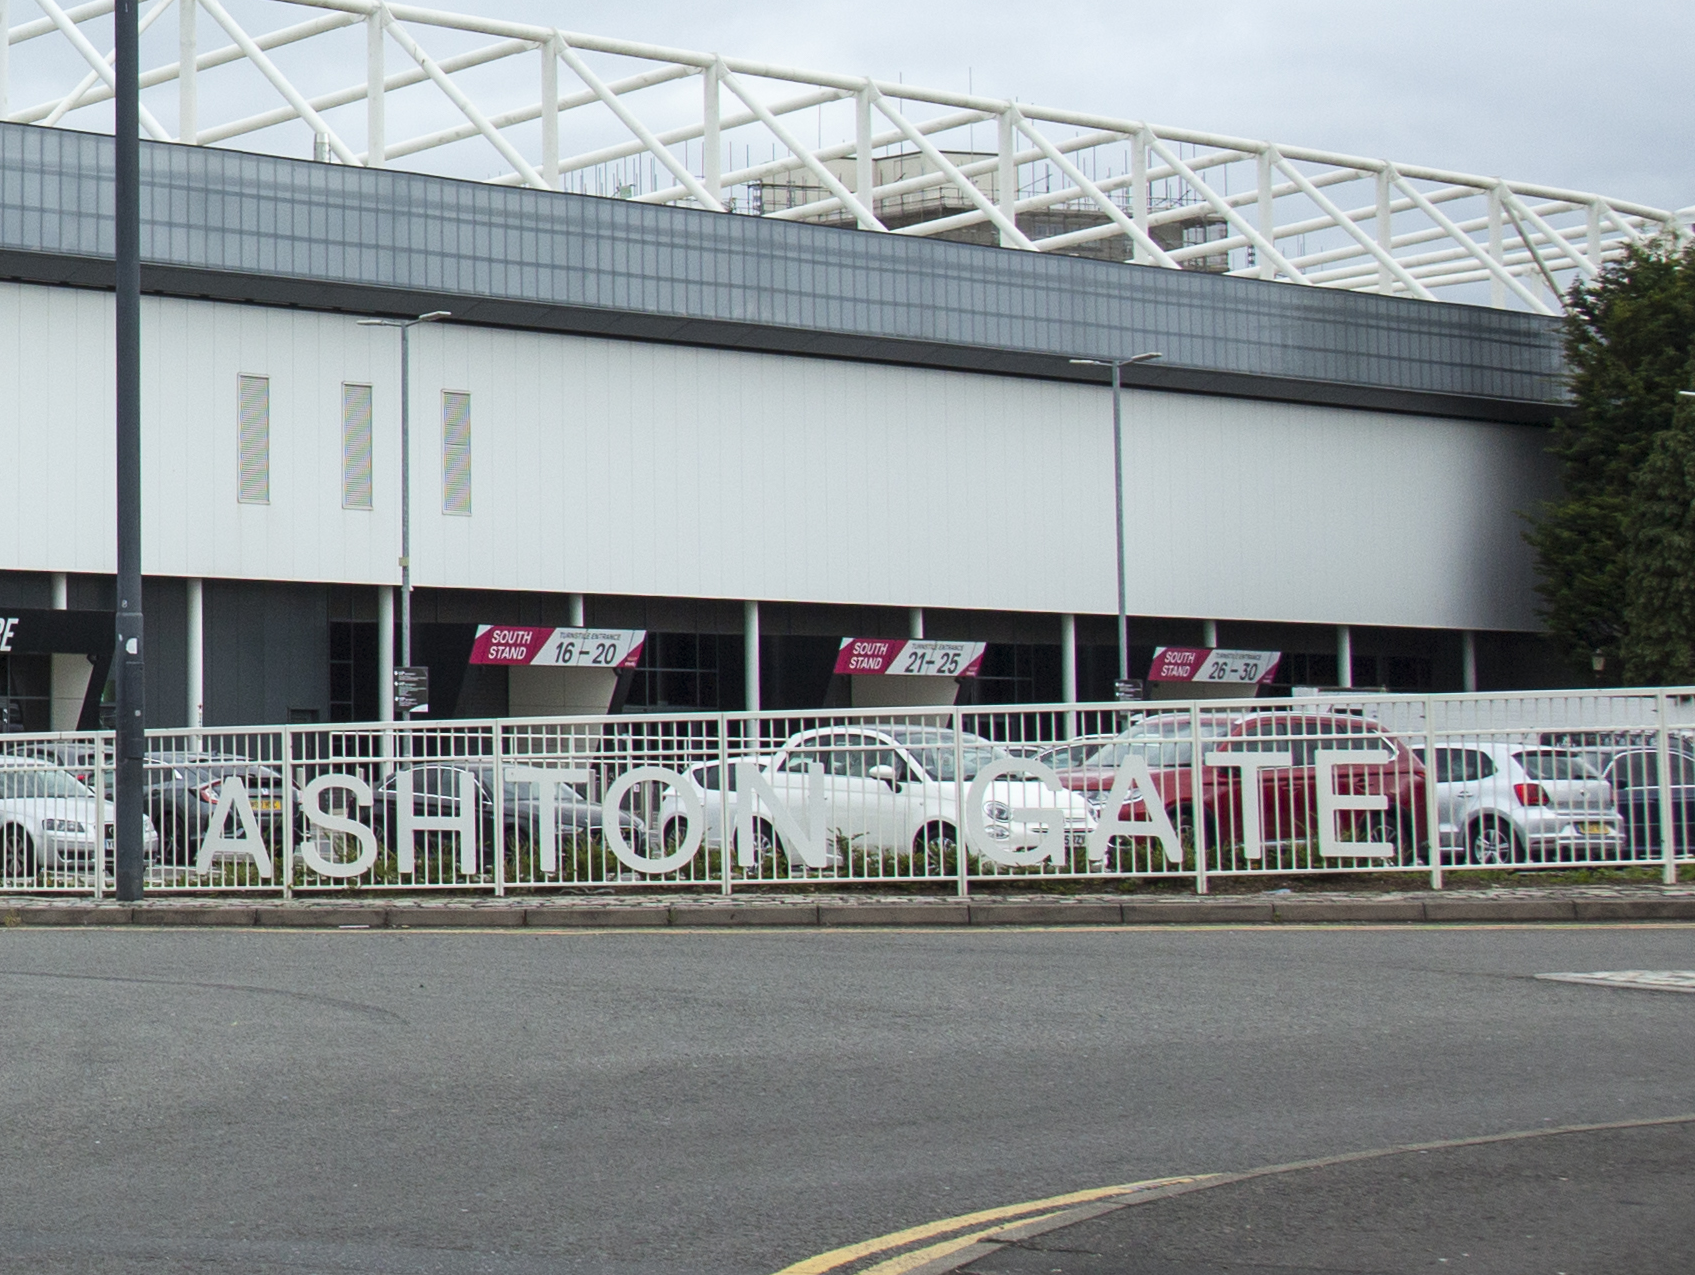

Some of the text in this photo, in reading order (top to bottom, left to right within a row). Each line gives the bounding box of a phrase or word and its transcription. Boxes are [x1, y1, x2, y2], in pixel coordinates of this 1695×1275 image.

[491, 629, 533, 645] SOUTH
[488, 645, 527, 660] STAND
[555, 641, 576, 664] 16
[592, 642, 617, 665] 20
[853, 642, 889, 656] SOUTH
[849, 656, 883, 670] STAND
[904, 651, 927, 673] 21
[936, 652, 962, 674] 25
[1164, 651, 1196, 664] SOUTH
[1160, 664, 1191, 677] STAND
[1208, 661, 1229, 680] 26
[1239, 662, 1258, 681] 30
[196, 750, 1395, 878] ASHTON GATE
